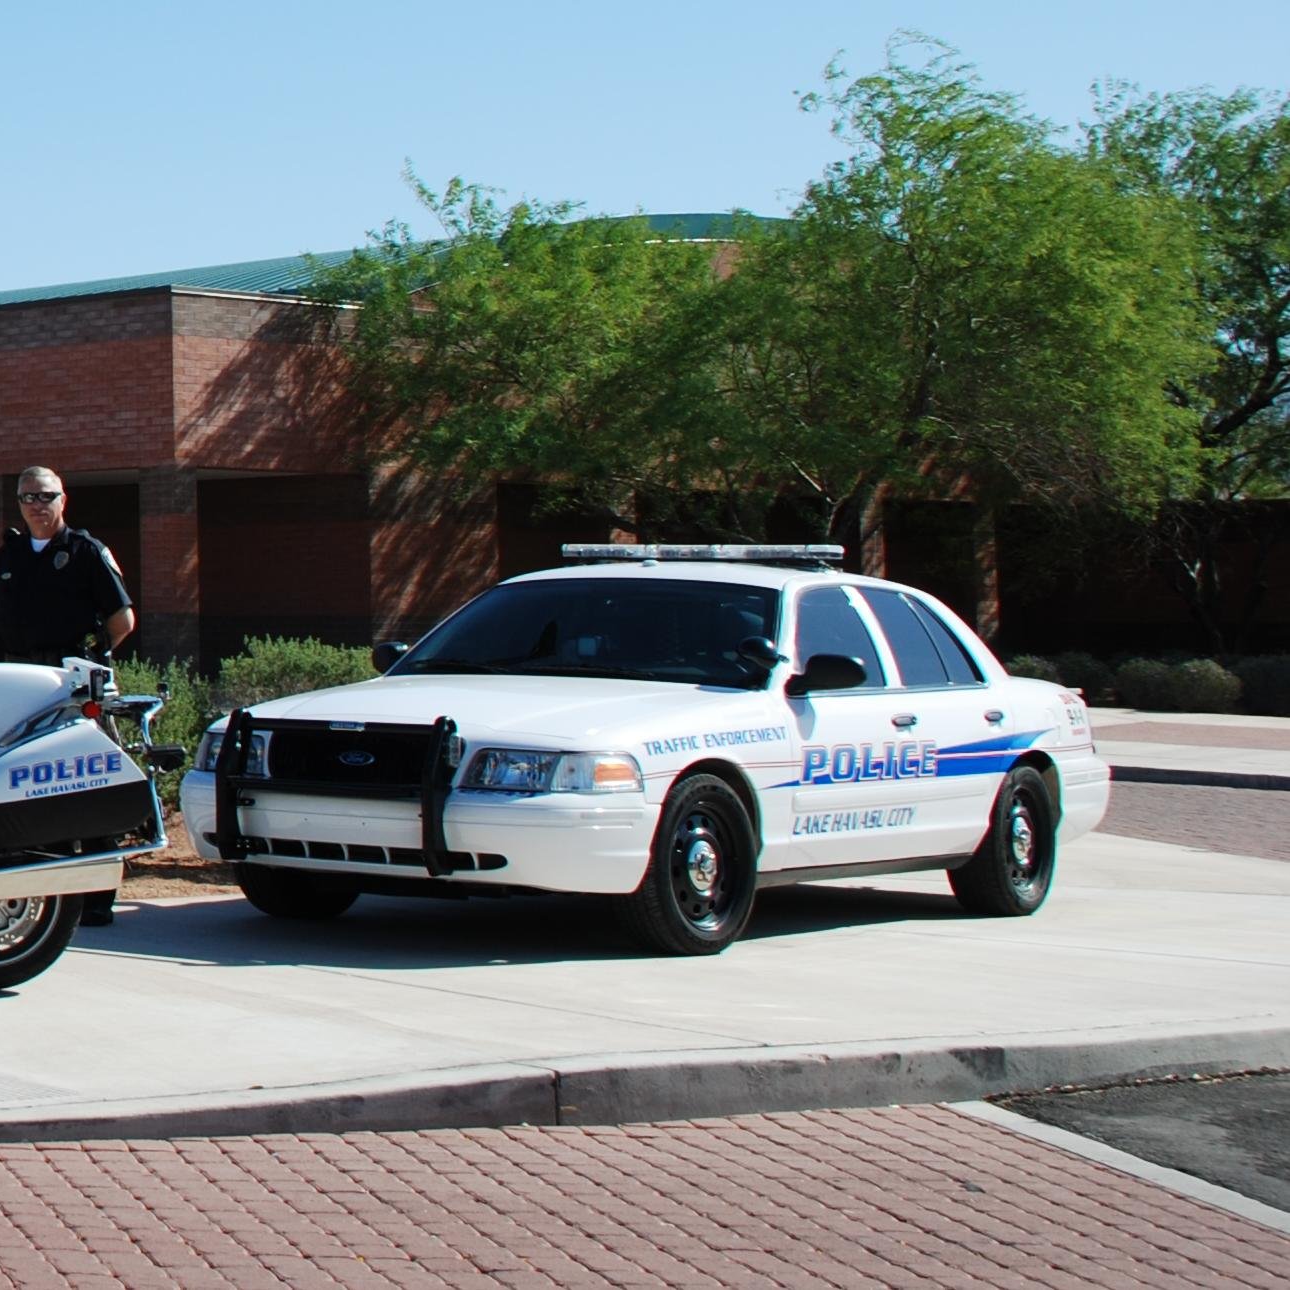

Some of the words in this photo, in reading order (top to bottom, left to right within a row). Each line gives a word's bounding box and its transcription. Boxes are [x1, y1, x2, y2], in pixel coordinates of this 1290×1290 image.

[643, 735, 700, 756] TRAFFIC
[703, 725, 787, 748] ENFORCEMENT
[9, 750, 122, 790] POLICE
[799, 740, 937, 785] POLICE
[24, 787, 51, 798] LAKE
[51, 781, 90, 794] HAVASU
[89, 777, 110, 788] CITY
[792, 813, 831, 836] LAKE
[830, 809, 886, 832] HAVASU
[886, 805, 917, 827] CITY
